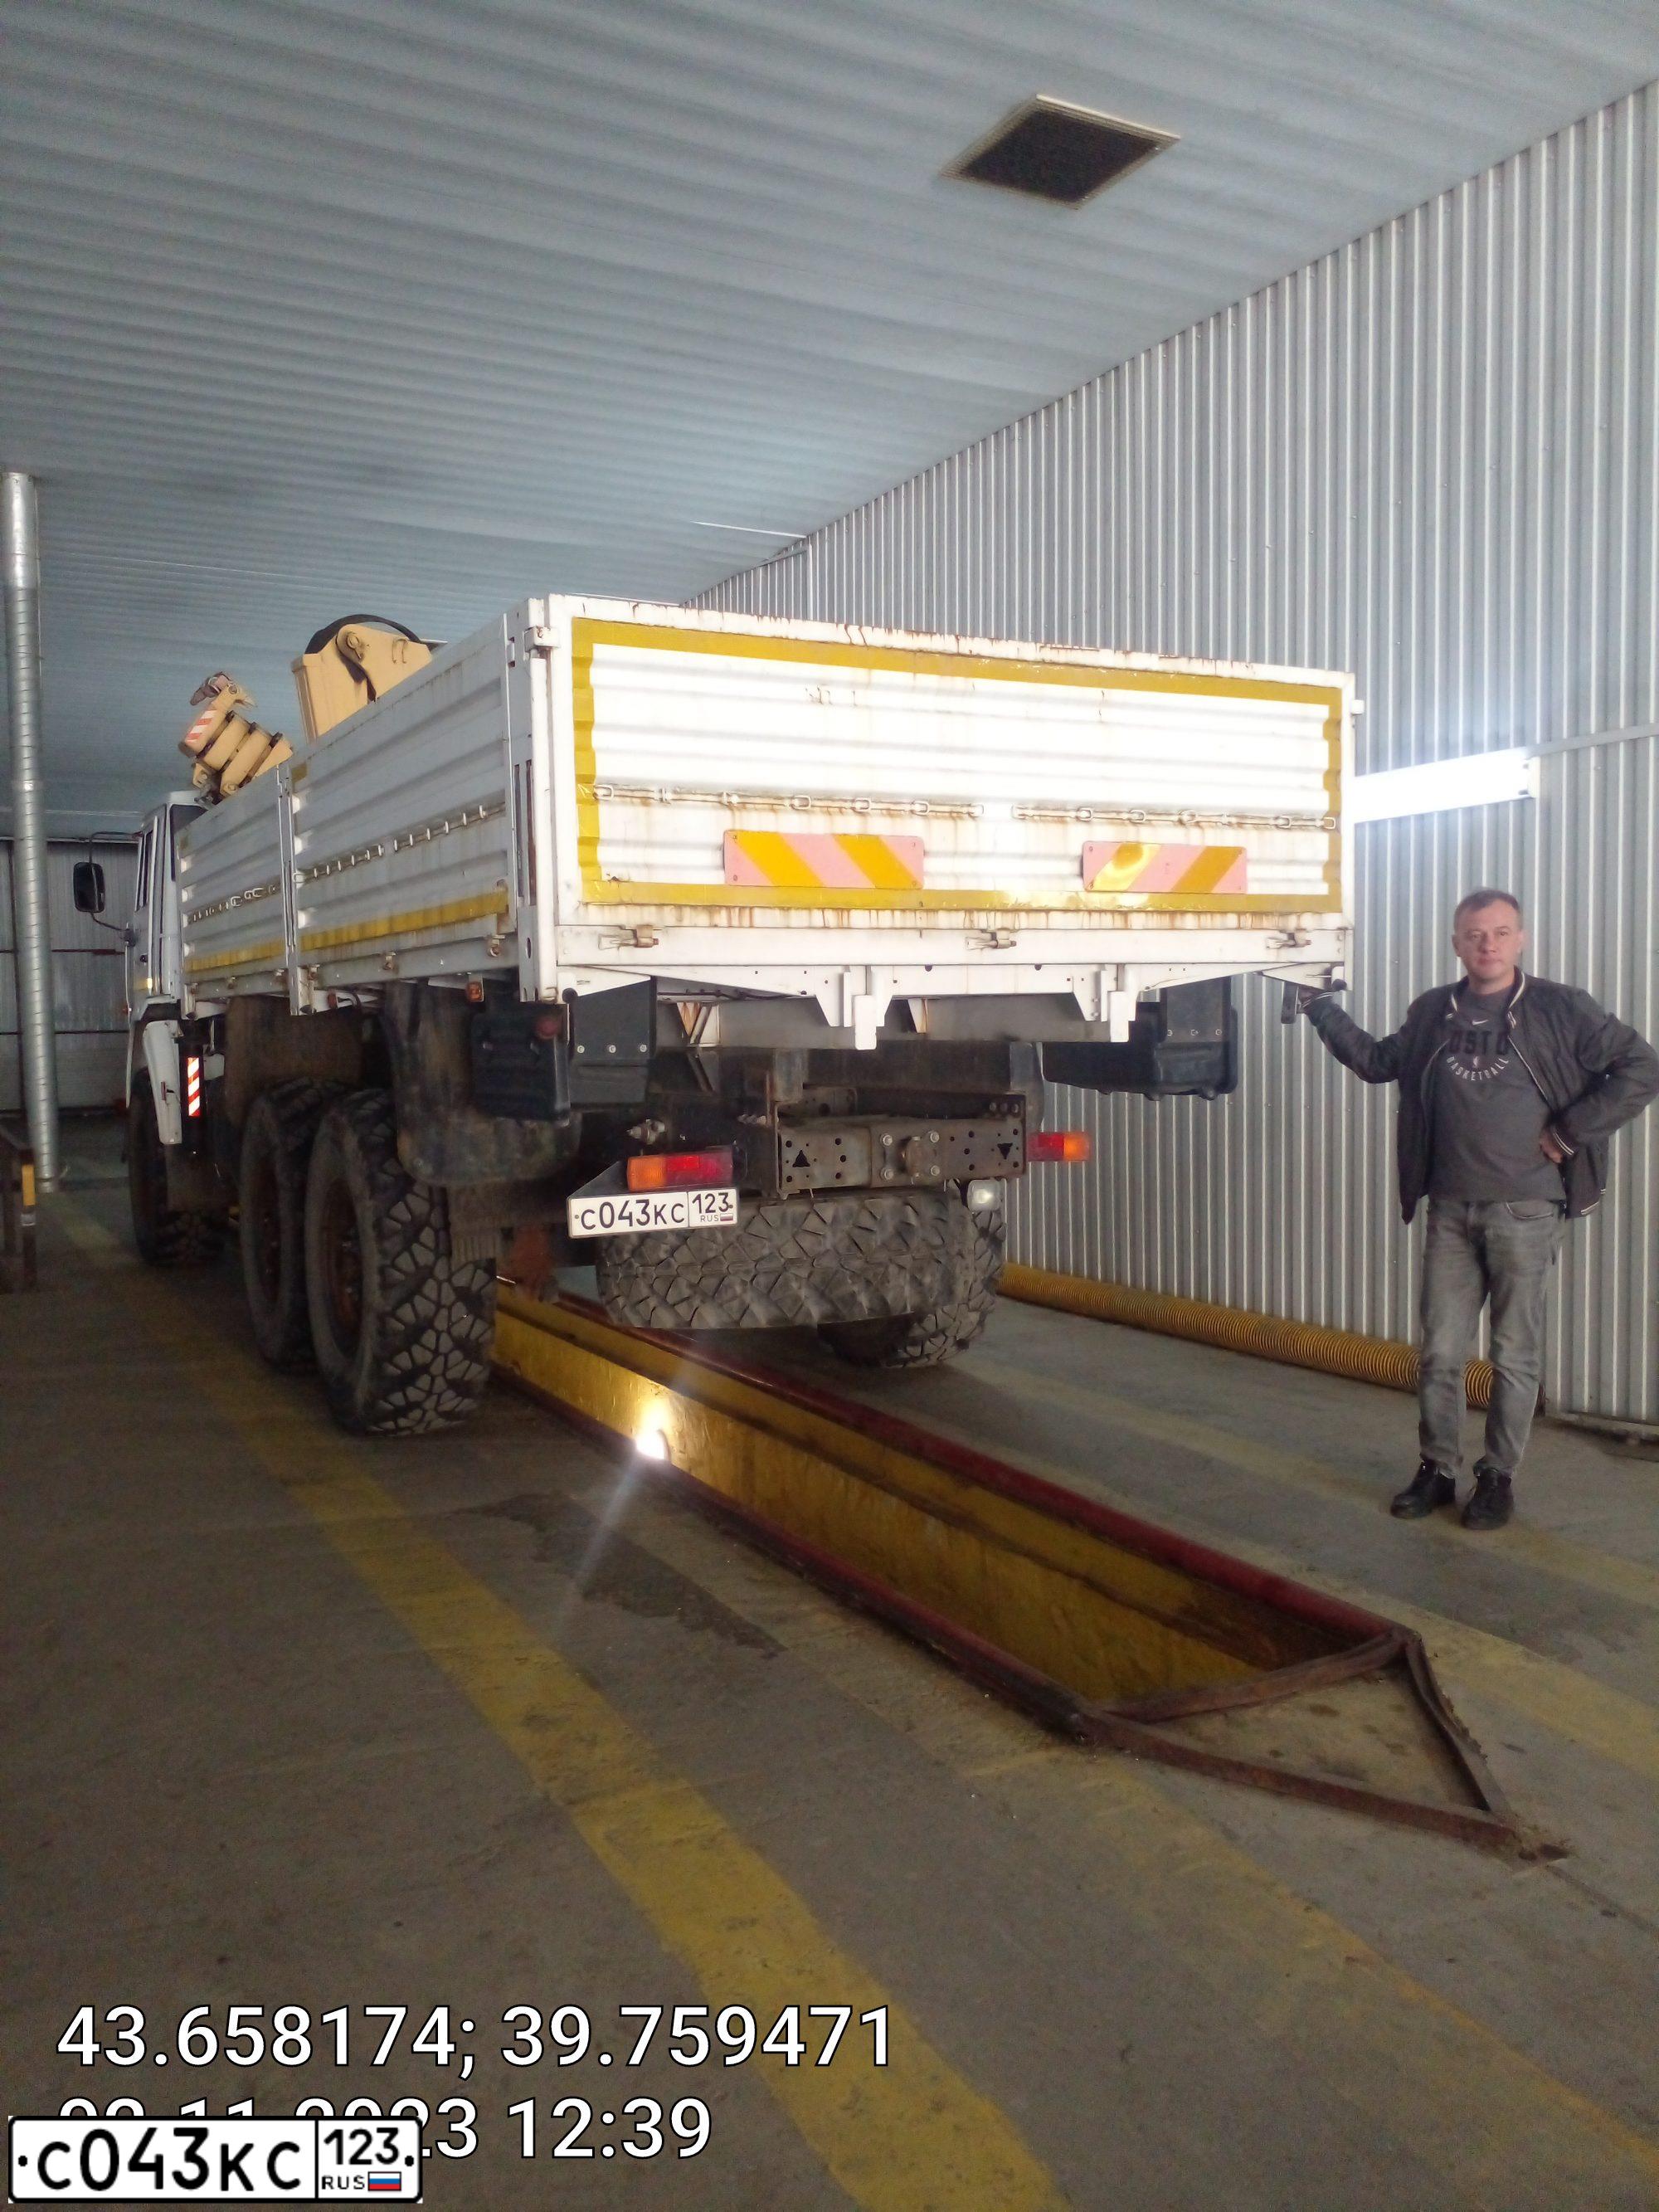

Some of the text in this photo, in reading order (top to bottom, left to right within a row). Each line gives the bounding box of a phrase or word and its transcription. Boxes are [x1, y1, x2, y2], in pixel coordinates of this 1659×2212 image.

[1446, 1055, 1509, 1081] BASKETBALL
[692, 1192, 730, 1214] 123
[700, 1214, 720, 1223] RUS
